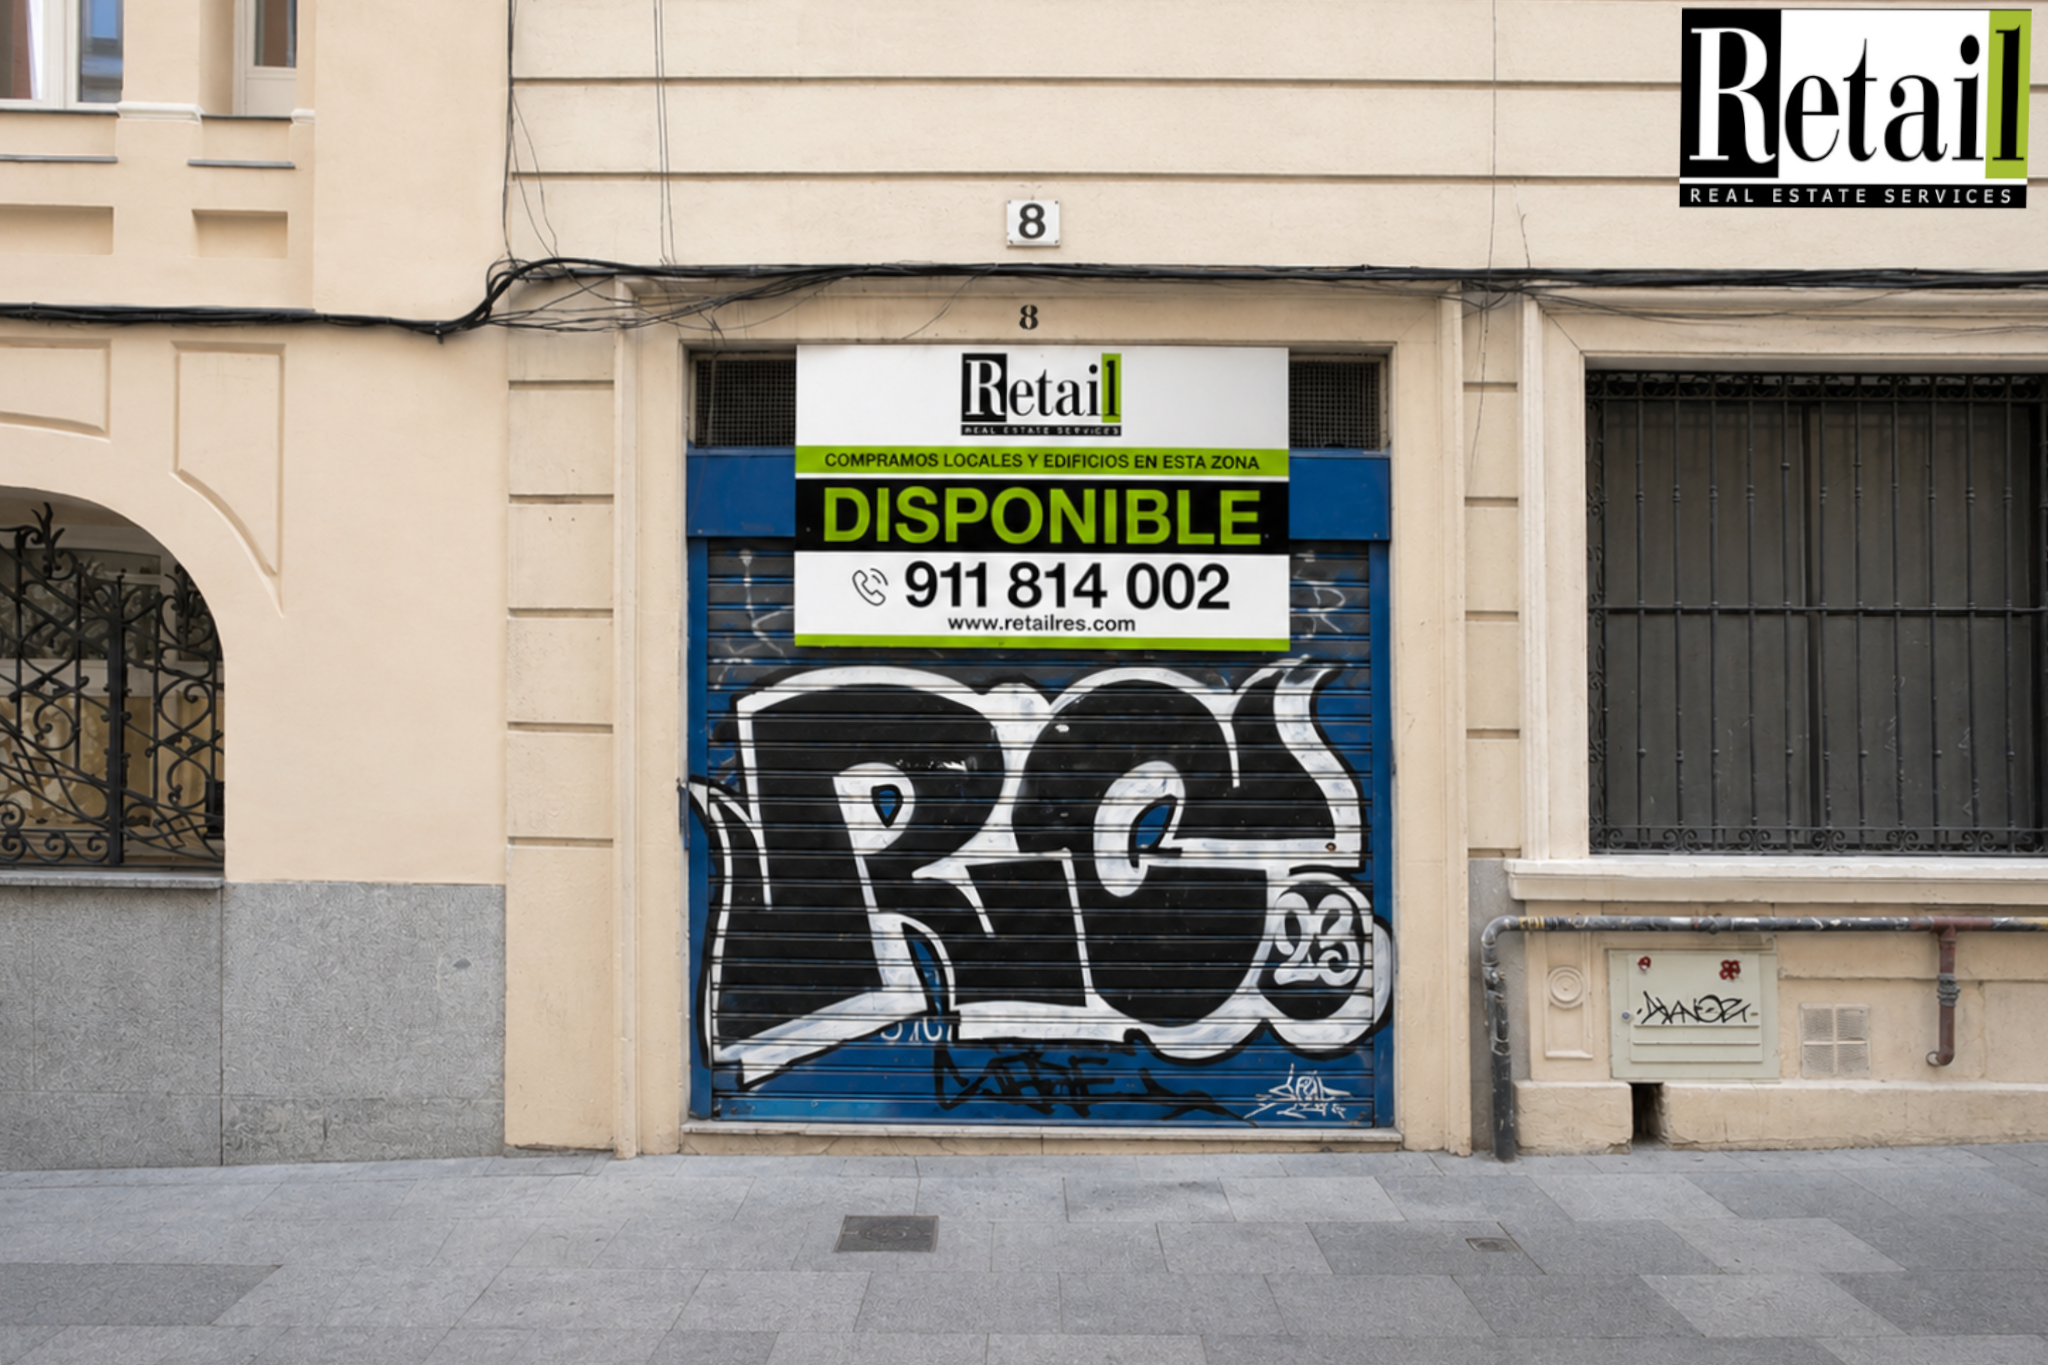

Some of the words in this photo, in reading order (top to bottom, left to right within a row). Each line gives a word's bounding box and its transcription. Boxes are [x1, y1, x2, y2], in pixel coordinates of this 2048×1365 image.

[1018, 202, 1046, 240] 8
[1019, 304, 1039, 330] 8
[965, 359, 1120, 416] Retail
[964, 427, 996, 435] REAL
[1003, 427, 1050, 435] ESTATE
[1056, 427, 1119, 435] SERVICES
[825, 453, 939, 468] COMPRAMOS
[944, 453, 1023, 468] LOCALES
[1027, 454, 1038, 468] Y
[1044, 454, 1130, 469] EDIFICIOS
[1134, 455, 1158, 469] EN
[1163, 455, 1207, 470] ESTA
[1211, 455, 1261, 470] ZONA
[823, 486, 1261, 545] DISPONIBLE
[905, 561, 988, 608] 911
[1007, 562, 1107, 609] 814
[1126, 563, 1230, 610] 002
[948, 614, 1136, 632] www.retailres.com
